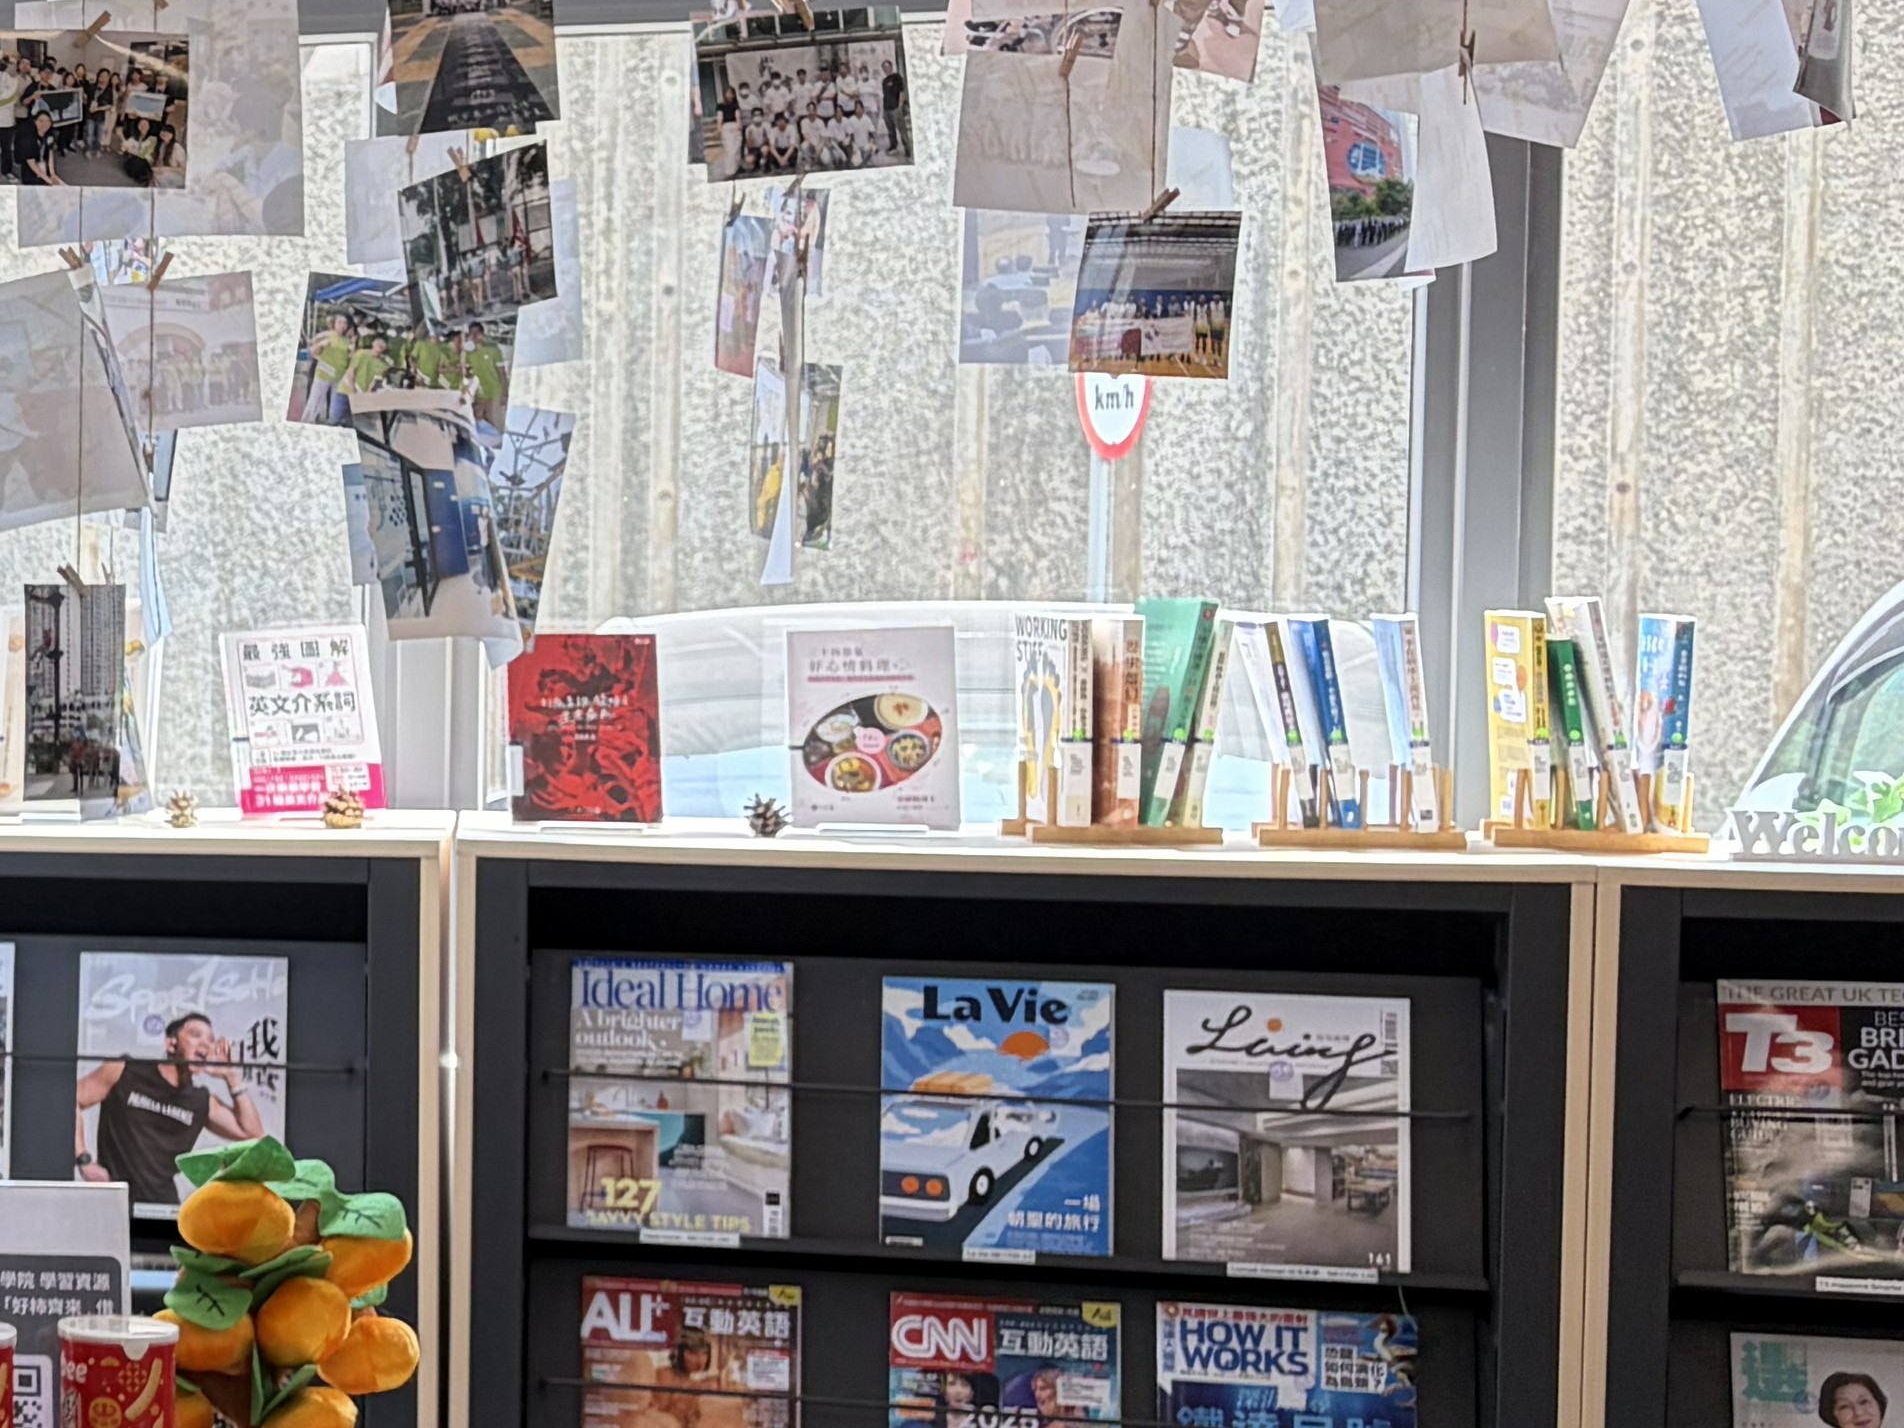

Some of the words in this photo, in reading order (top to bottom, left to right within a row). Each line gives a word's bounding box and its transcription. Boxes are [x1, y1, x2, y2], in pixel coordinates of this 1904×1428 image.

[1095, 383, 1135, 410] km/h
[1015, 615, 1068, 641] WORKING
[243, 639, 349, 661] 最強圖解
[249, 691, 356, 717] 英文介系詞
[1726, 807, 1904, 856] Welco
[580, 969, 665, 1010] Ideal
[676, 972, 782, 1013] Home
[922, 985, 982, 1023] La
[987, 987, 1069, 1025] Vie
[1770, 986, 1836, 1003] GREAT
[1842, 987, 1873, 1003] UK
[1878, 987, 1904, 1003] TE
[596, 1009, 682, 1032] brighter
[1725, 1013, 1834, 1074] T3
[1848, 1049, 1904, 1071] GAD
[600, 1176, 662, 1213] 127
[585, 1209, 643, 1226] SAVVY
[648, 1211, 707, 1231] STYLE
[710, 1214, 751, 1233] TIPS
[682, 1306, 791, 1339] 互動英語
[891, 1315, 988, 1362] CNN
[1180, 1318, 1266, 1349] HOW
[1274, 1324, 1309, 1350] IT
[997, 1327, 1109, 1361] 互動英語
[1180, 1344, 1310, 1376] WORKS
